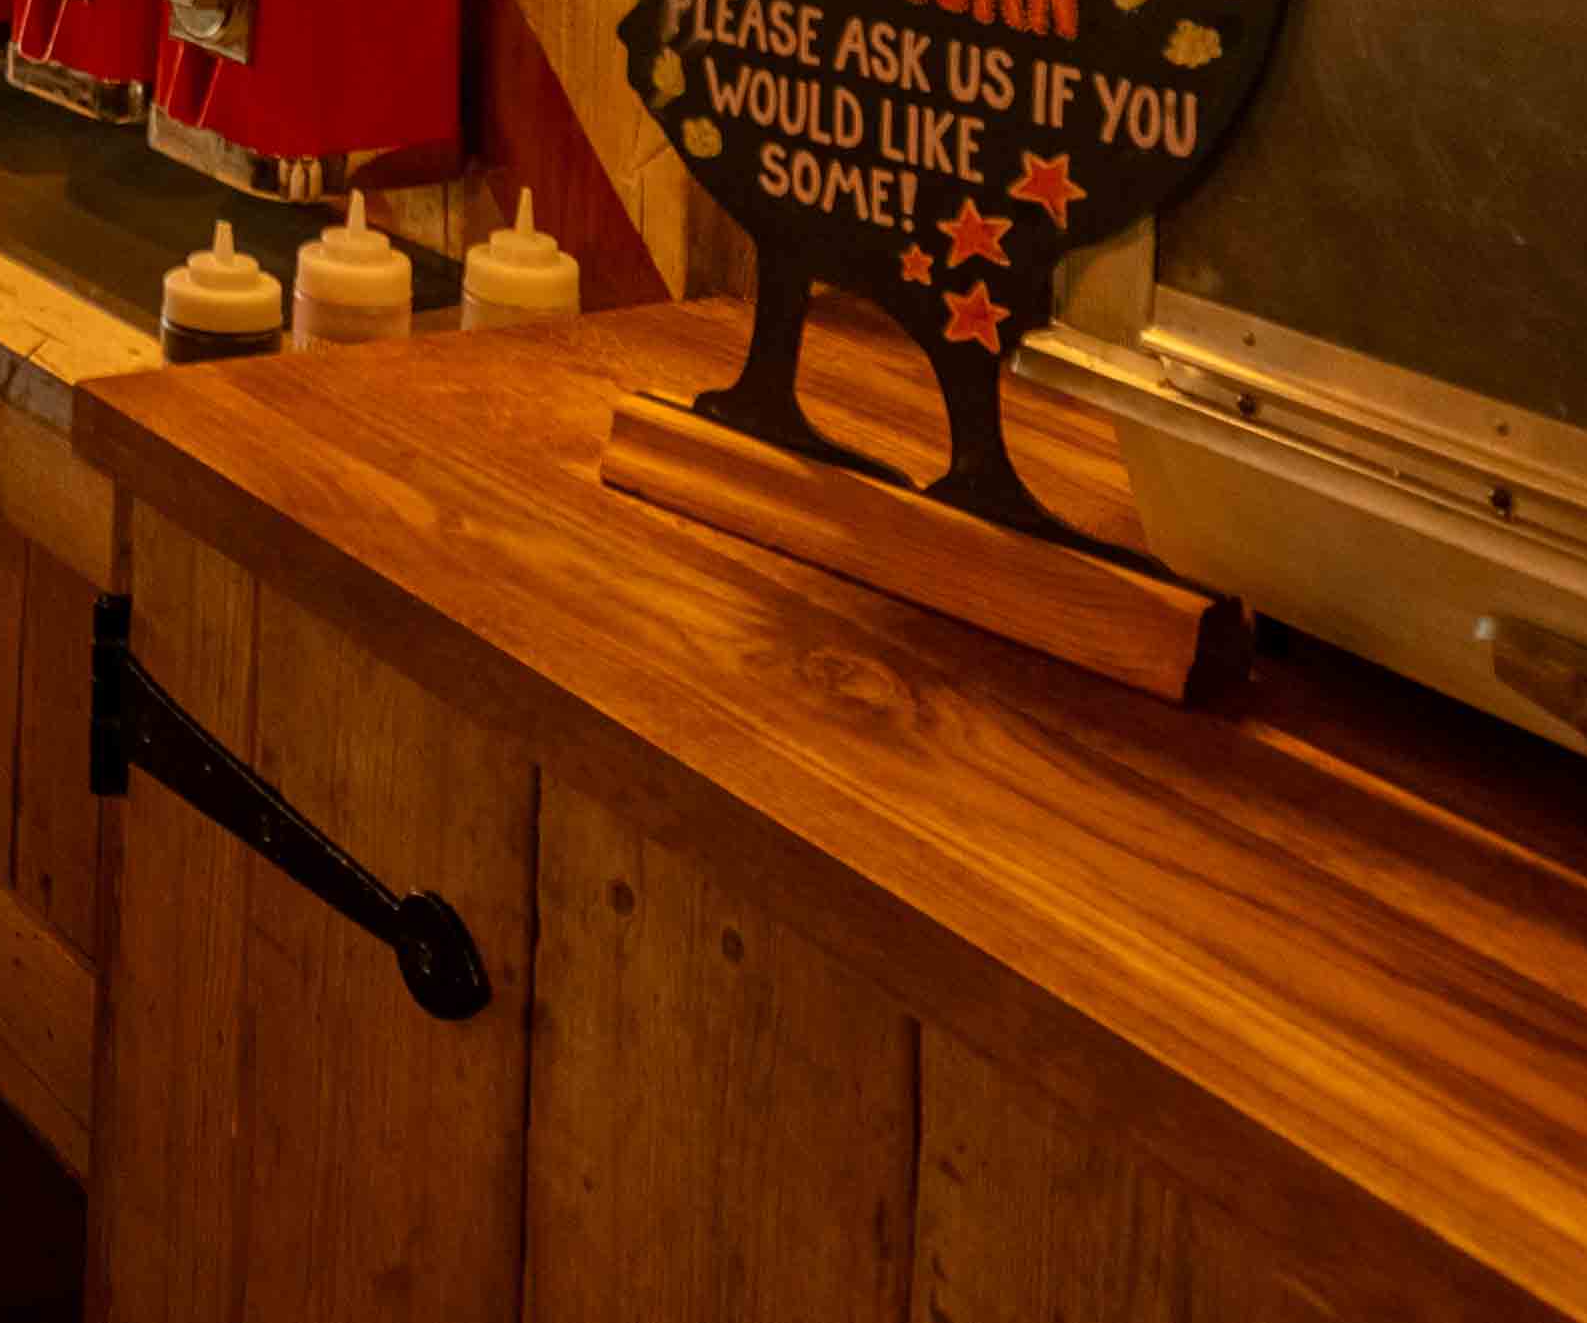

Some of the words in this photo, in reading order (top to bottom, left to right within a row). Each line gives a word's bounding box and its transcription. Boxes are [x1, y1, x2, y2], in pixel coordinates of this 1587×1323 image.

[704, 57, 864, 150] WOULD
[880, 105, 985, 183] LIKE
[834, 26, 931, 94] ASK
[948, 48, 1016, 110] US
[1033, 61, 1081, 128] IF
[1092, 72, 1199, 158] YOU
[759, 144, 916, 231] SOME!
